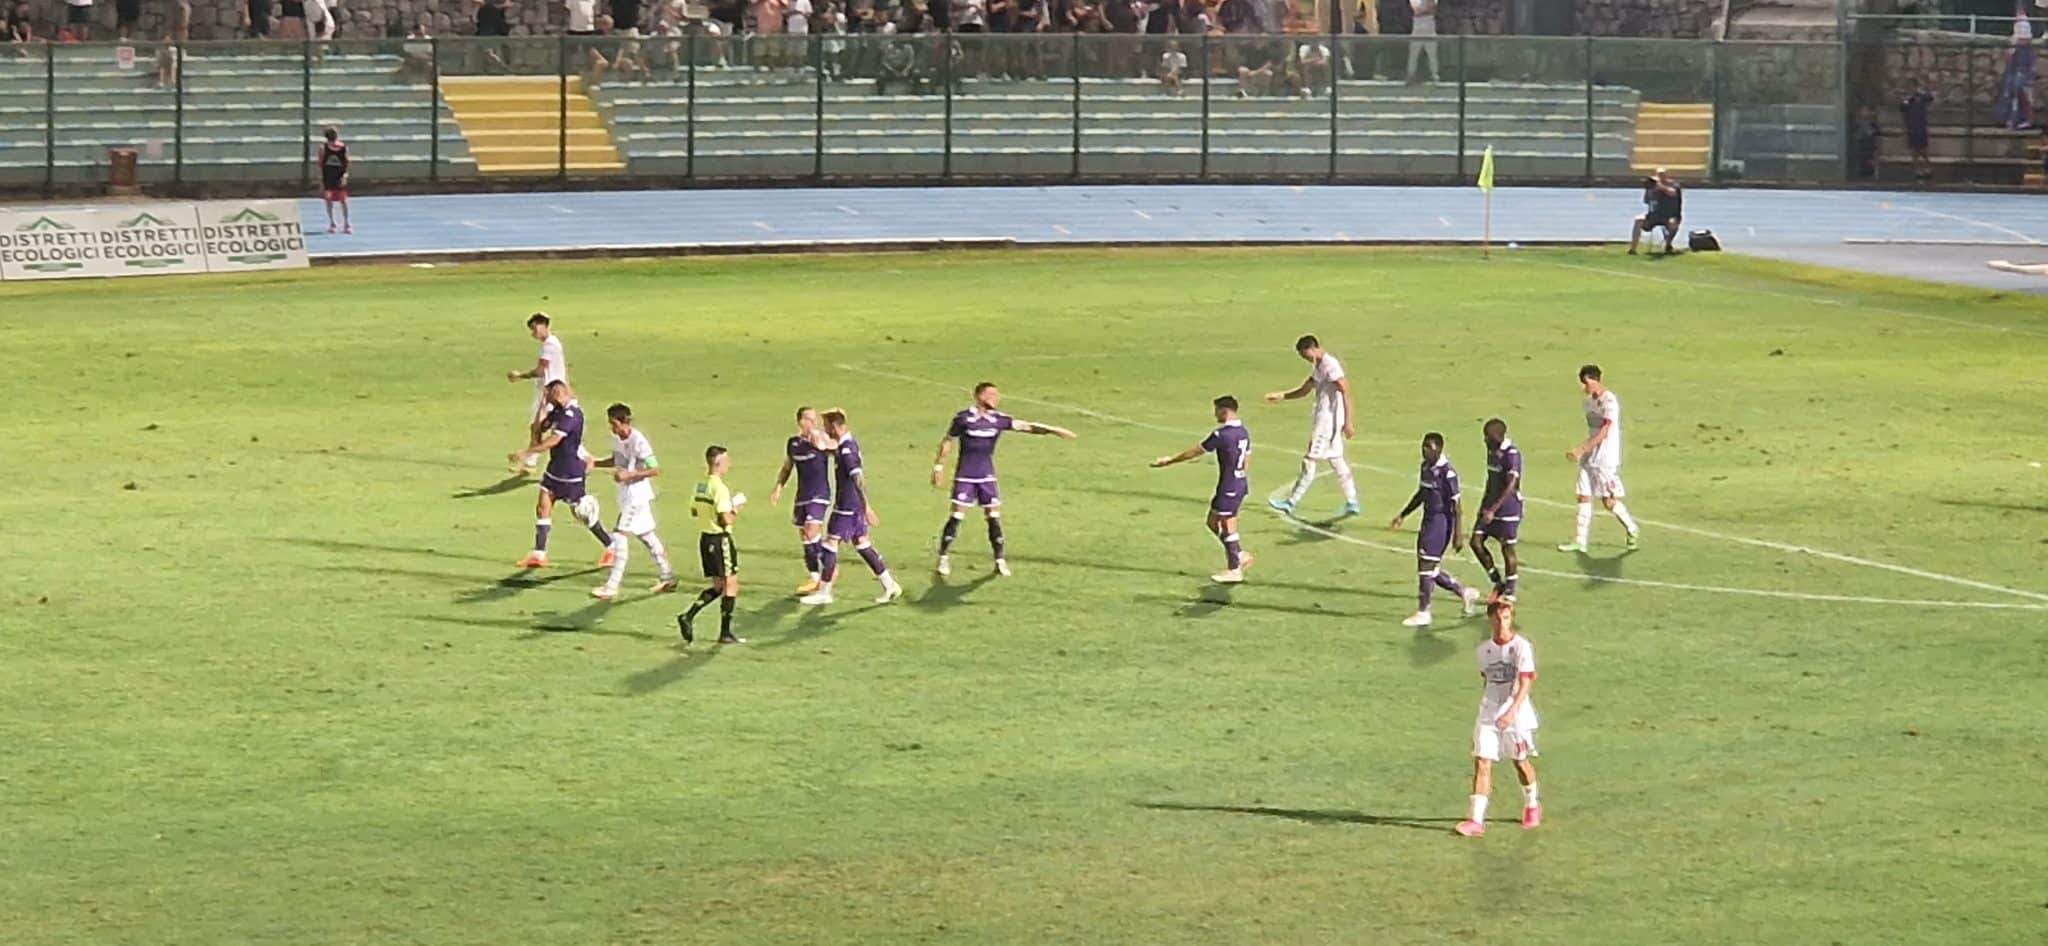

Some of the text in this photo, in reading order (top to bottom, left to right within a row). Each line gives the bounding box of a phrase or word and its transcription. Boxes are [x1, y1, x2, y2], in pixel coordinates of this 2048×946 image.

[100, 227, 198, 243] DISTRETTI
[204, 222, 301, 239] DISTRETTI
[0, 231, 97, 247] DISTRETTI
[206, 237, 304, 254] ECOLOGICI
[2, 247, 99, 262] ECOLOGICI
[104, 242, 200, 258] ECOLOGICI
